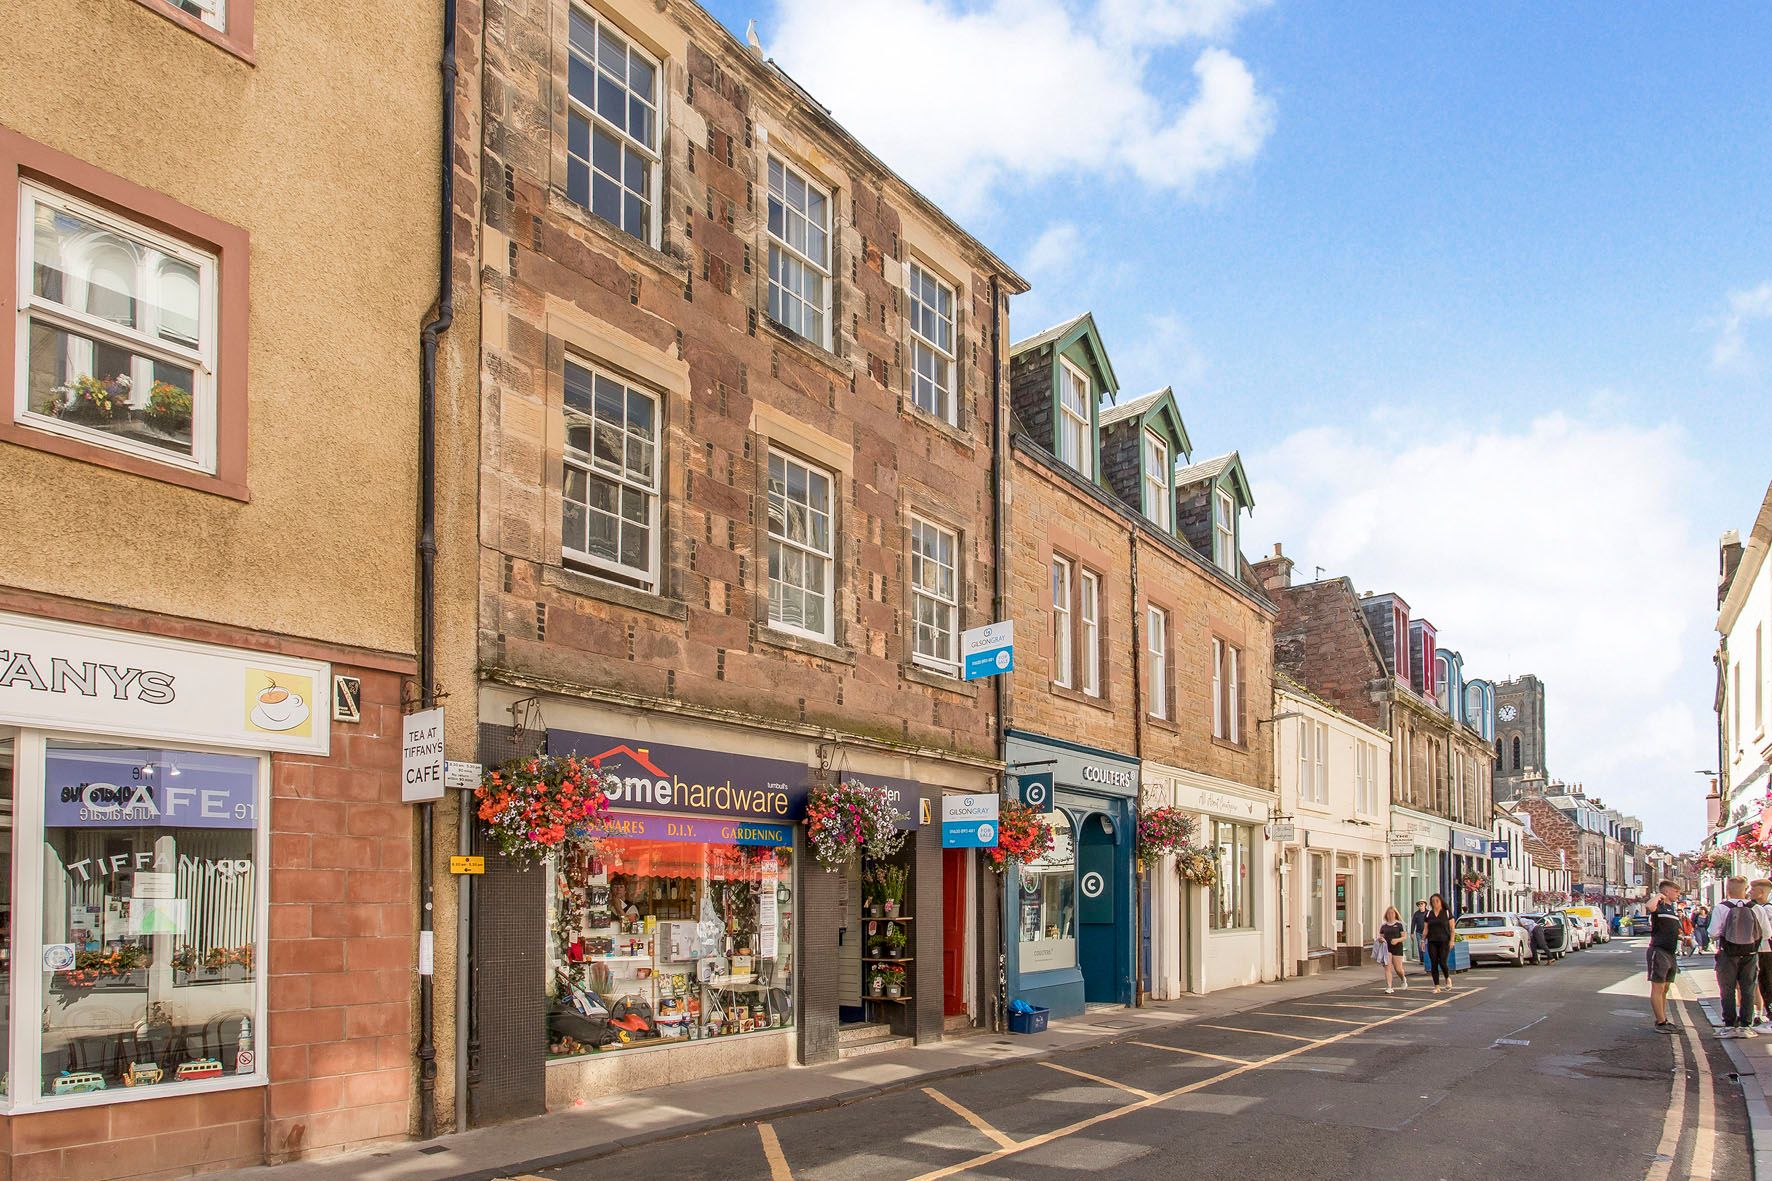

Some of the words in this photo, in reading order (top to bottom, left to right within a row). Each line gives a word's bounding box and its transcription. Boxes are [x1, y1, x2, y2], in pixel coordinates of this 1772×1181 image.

[409, 730, 425, 743] TEA
[426, 727, 437, 739] AT
[404, 740, 443, 759] TIFFANY'S
[406, 760, 440, 785] CAFÉ
[1085, 765, 1130, 788] COULTERS
[82, 782, 231, 819] CAFE
[603, 775, 789, 815] omehardware
[949, 807, 989, 816] GILSONGRAY
[667, 823, 697, 837] D.I.Y.
[721, 826, 783, 842] GARDENING
[67, 852, 232, 881] TIFFANY
